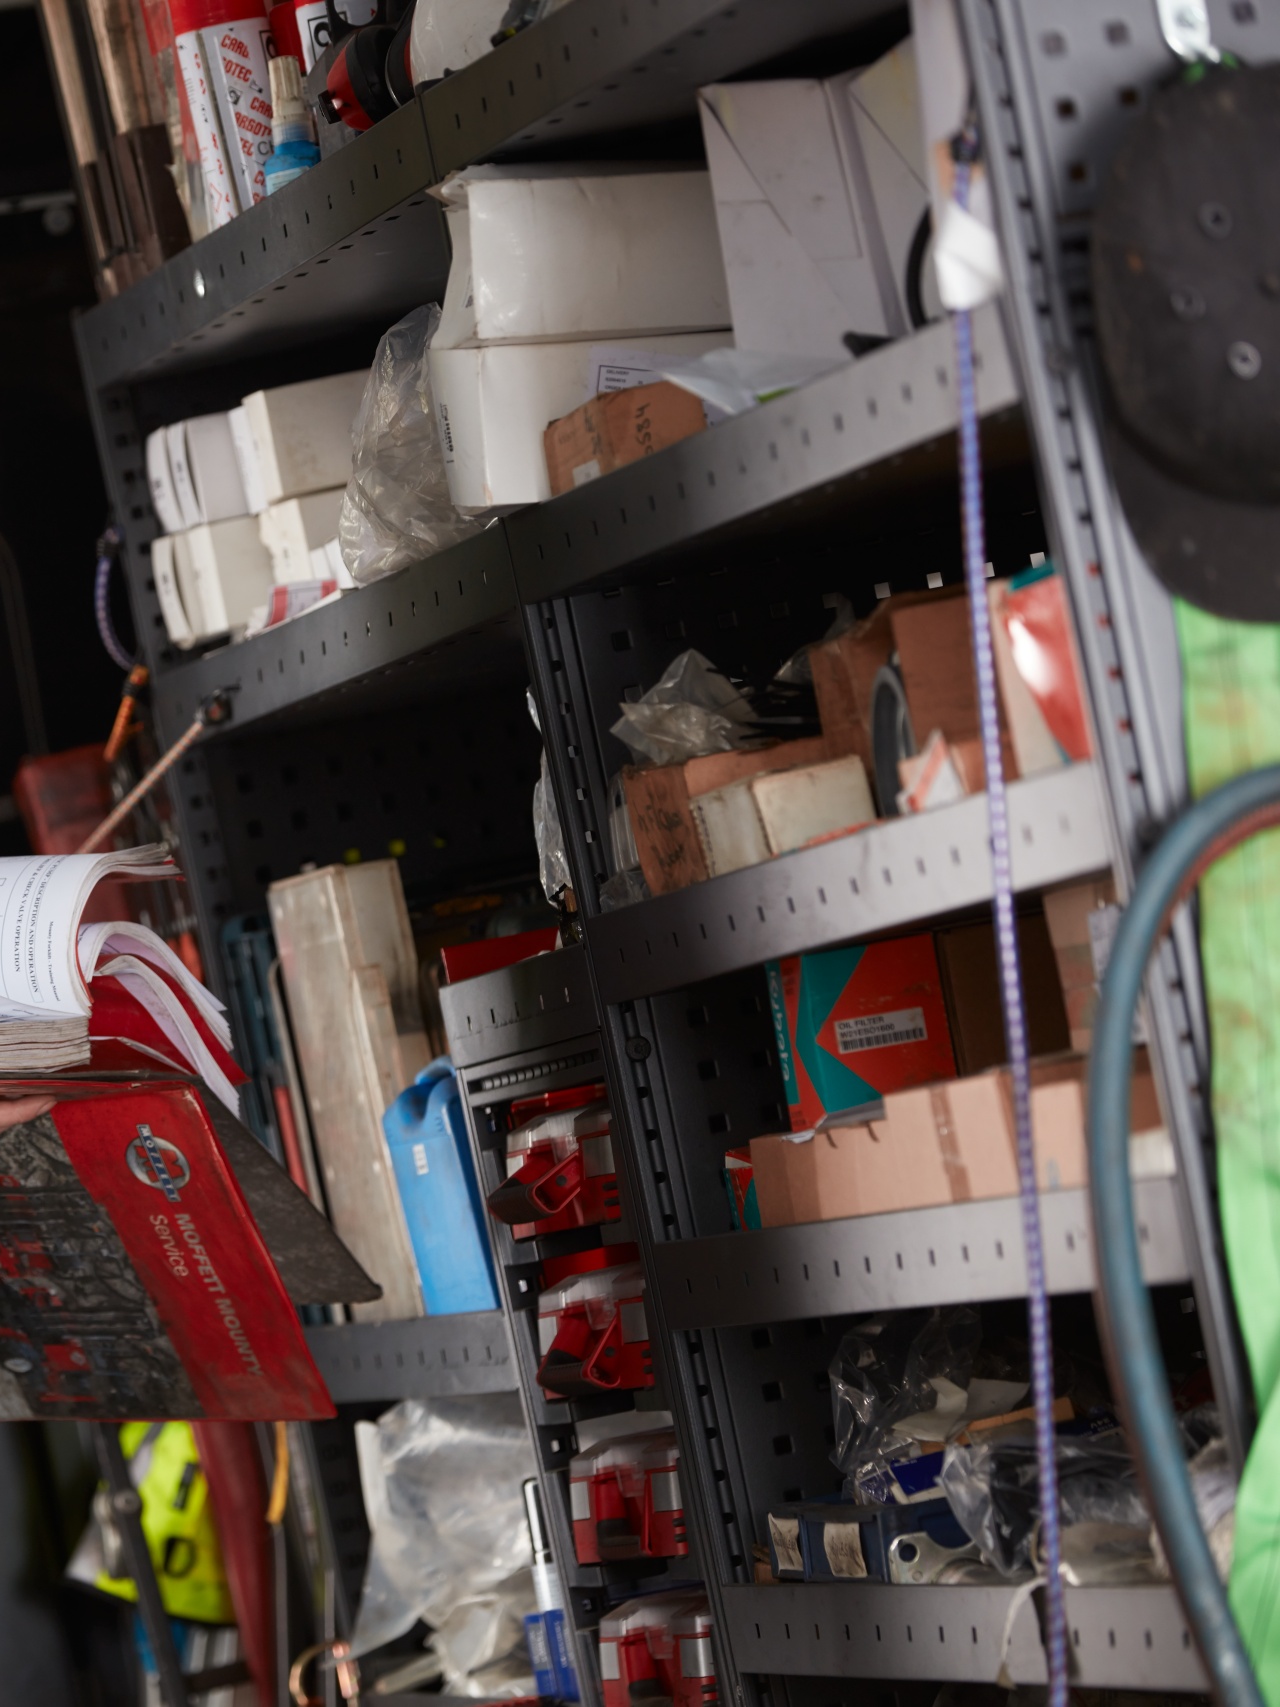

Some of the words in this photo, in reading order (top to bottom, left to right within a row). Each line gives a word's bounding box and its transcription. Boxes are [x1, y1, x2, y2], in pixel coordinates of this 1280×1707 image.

[22, 877, 35, 899] CHECK
[31, 881, 47, 927] DESCRIPTION
[17, 899, 27, 924] VALVE
[28, 946, 39, 993] OPERATION
[838, 1021, 852, 1031] OIL
[854, 1015, 885, 1028] FILTER
[149, 1214, 190, 1278] Service
[175, 1213, 226, 1293] MOFFETT
[215, 1298, 264, 1377] MOUNTY
